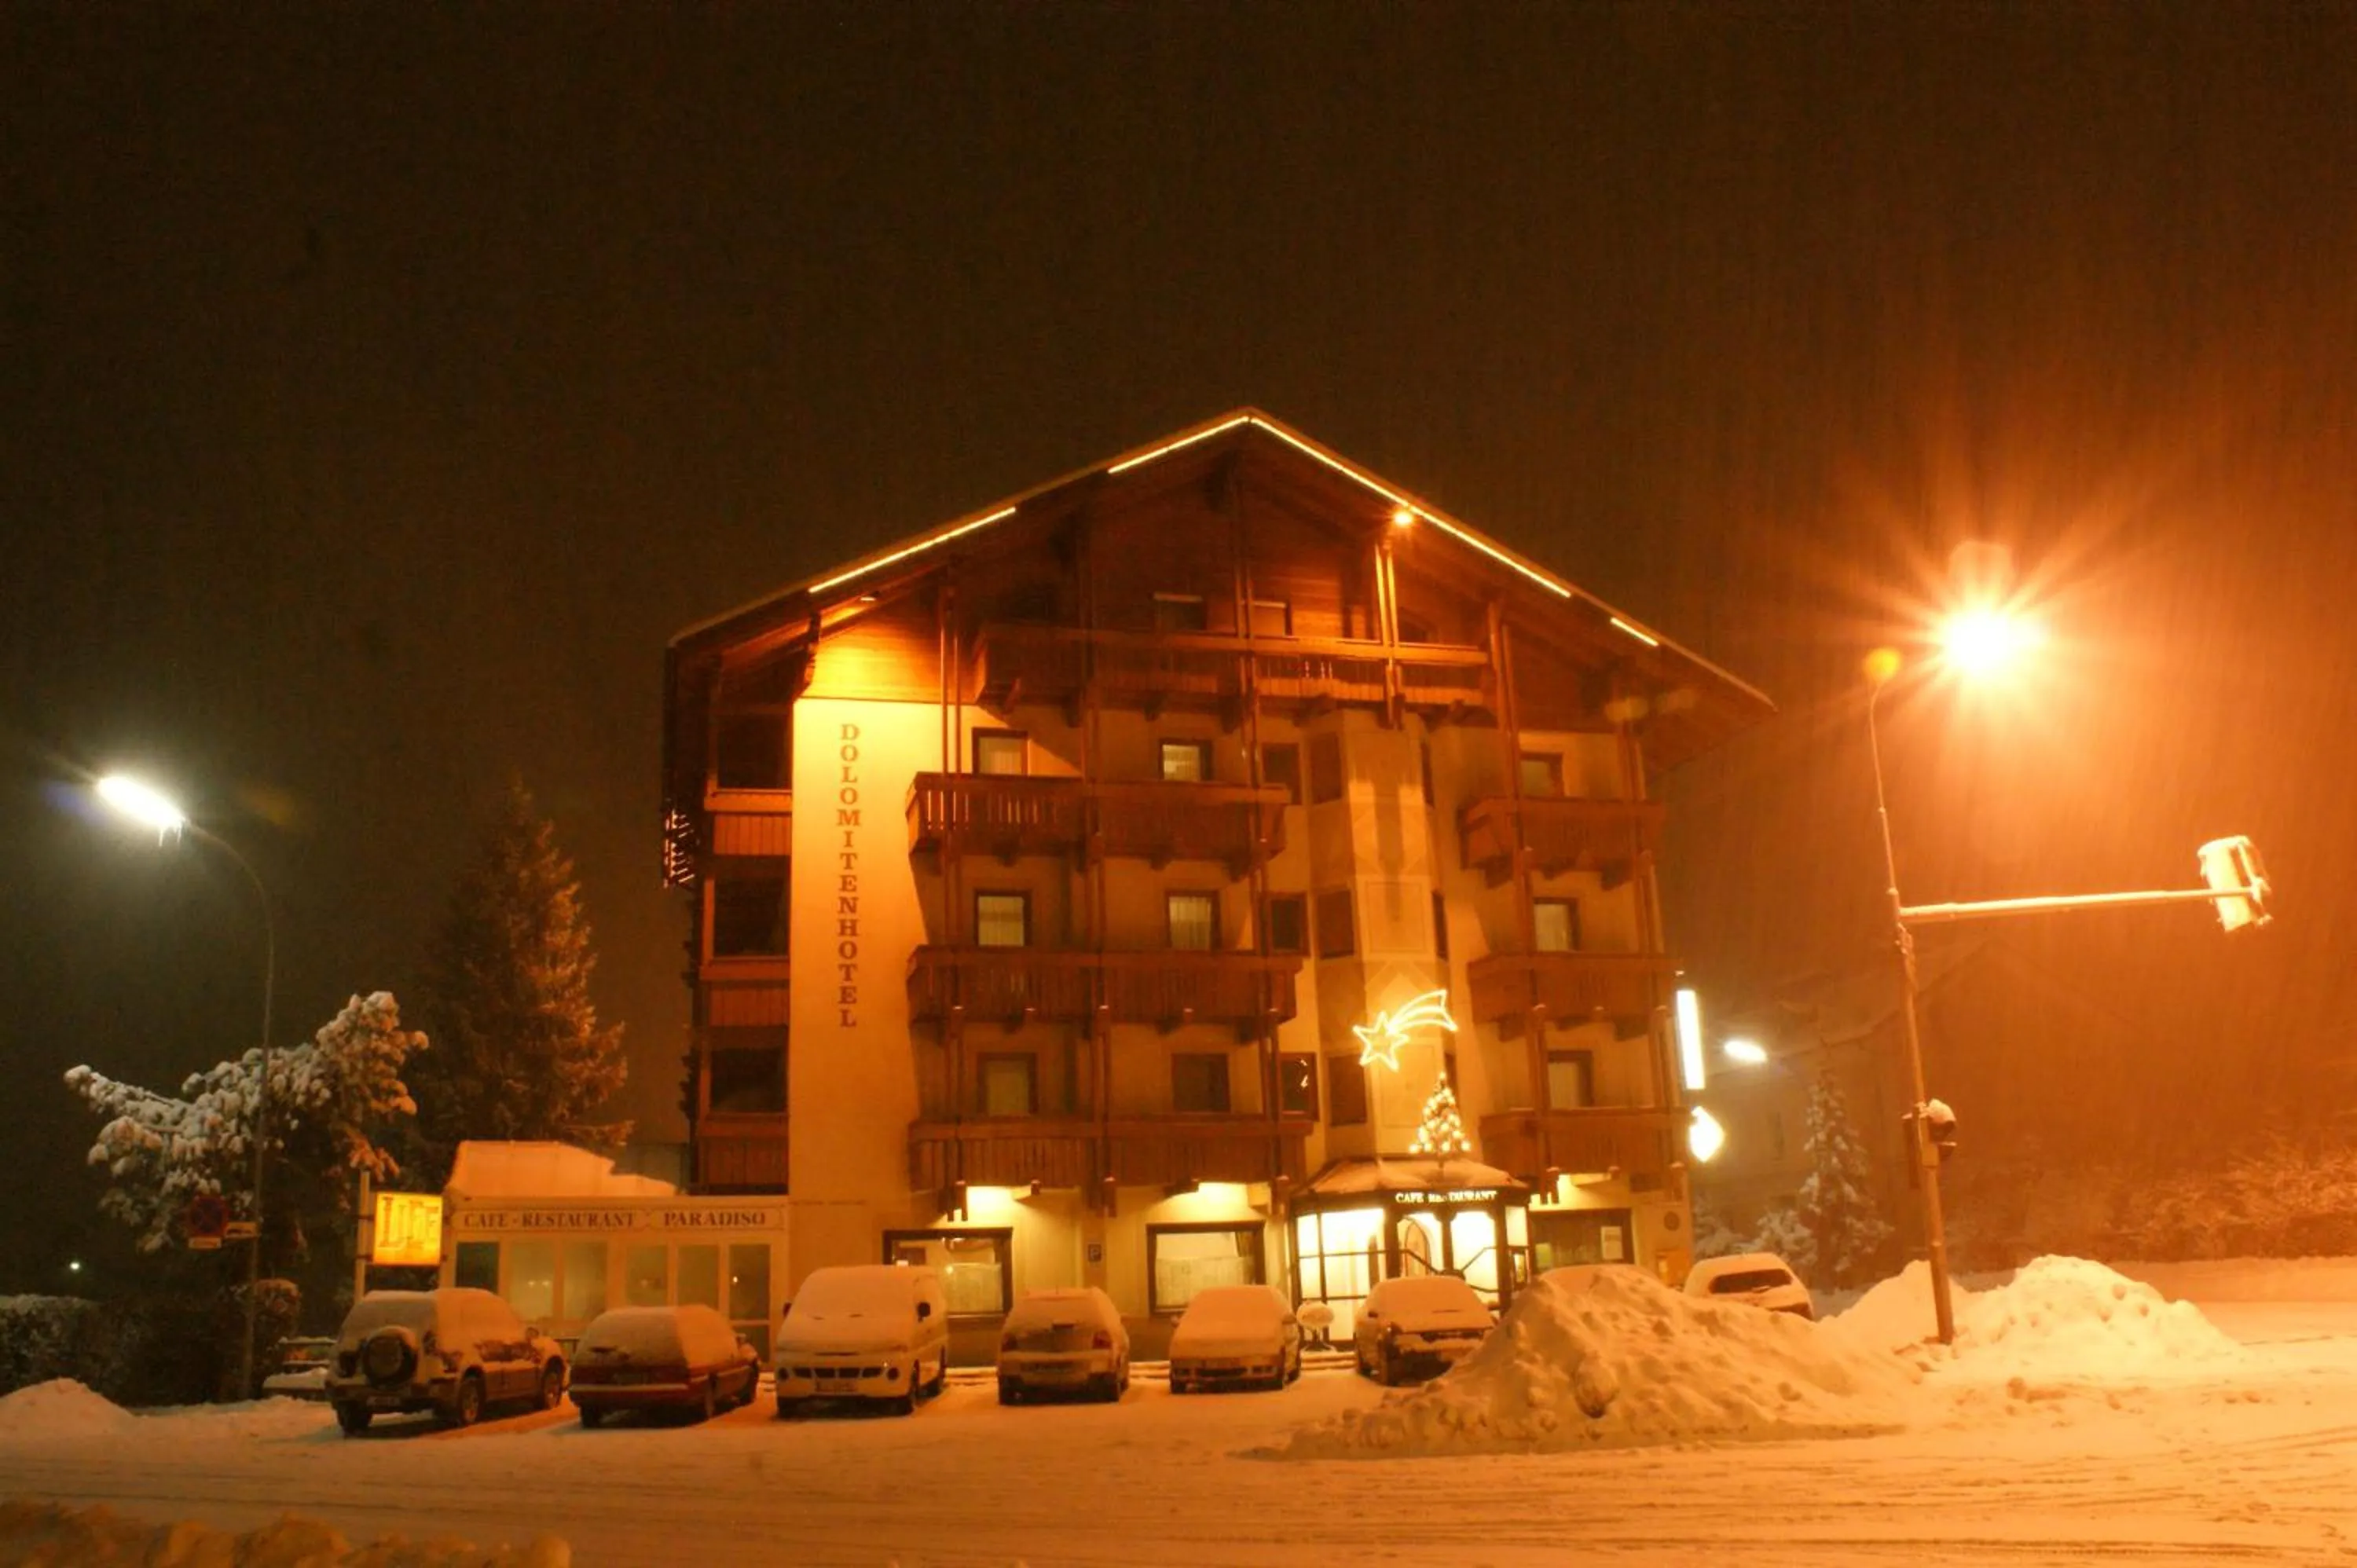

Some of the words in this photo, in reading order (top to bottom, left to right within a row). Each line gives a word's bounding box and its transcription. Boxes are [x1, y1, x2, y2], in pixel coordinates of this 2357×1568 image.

[837, 724, 861, 1028] DOLOMITENHOTEL
[522, 1211, 635, 1228] RESTAURANT
[664, 1211, 767, 1227] PARADISO
